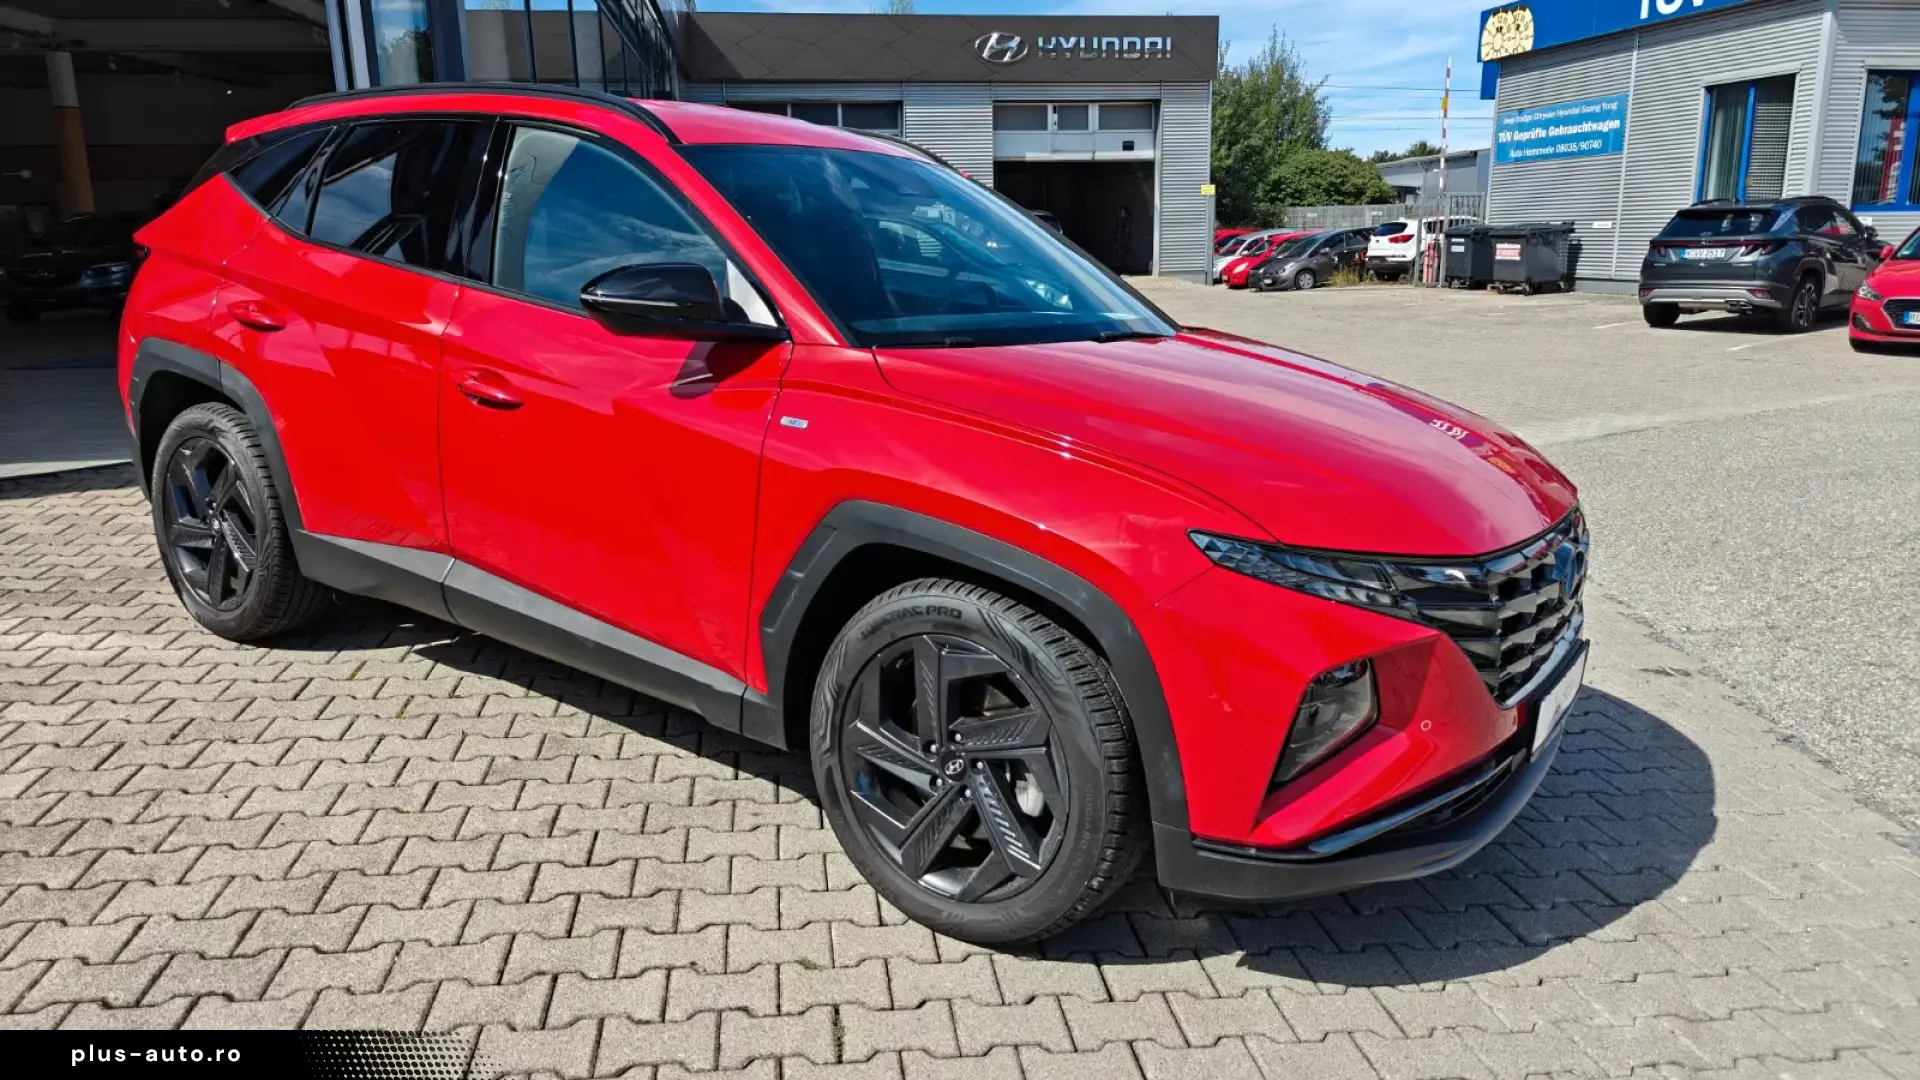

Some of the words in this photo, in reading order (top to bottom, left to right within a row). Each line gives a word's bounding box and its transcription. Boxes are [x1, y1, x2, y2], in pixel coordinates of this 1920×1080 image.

[1037, 36, 1172, 59] HYUNDAI
[1557, 107, 1580, 119] Hyundai
[1602, 101, 1618, 111] Yong
[1513, 127, 1547, 142] Geprüfte
[1548, 119, 1621, 137] Gebrauchtwagen
[1509, 148, 1523, 158] Auto
[1556, 138, 1603, 153] 08035/90740
[925, 605, 962, 619] PRO
